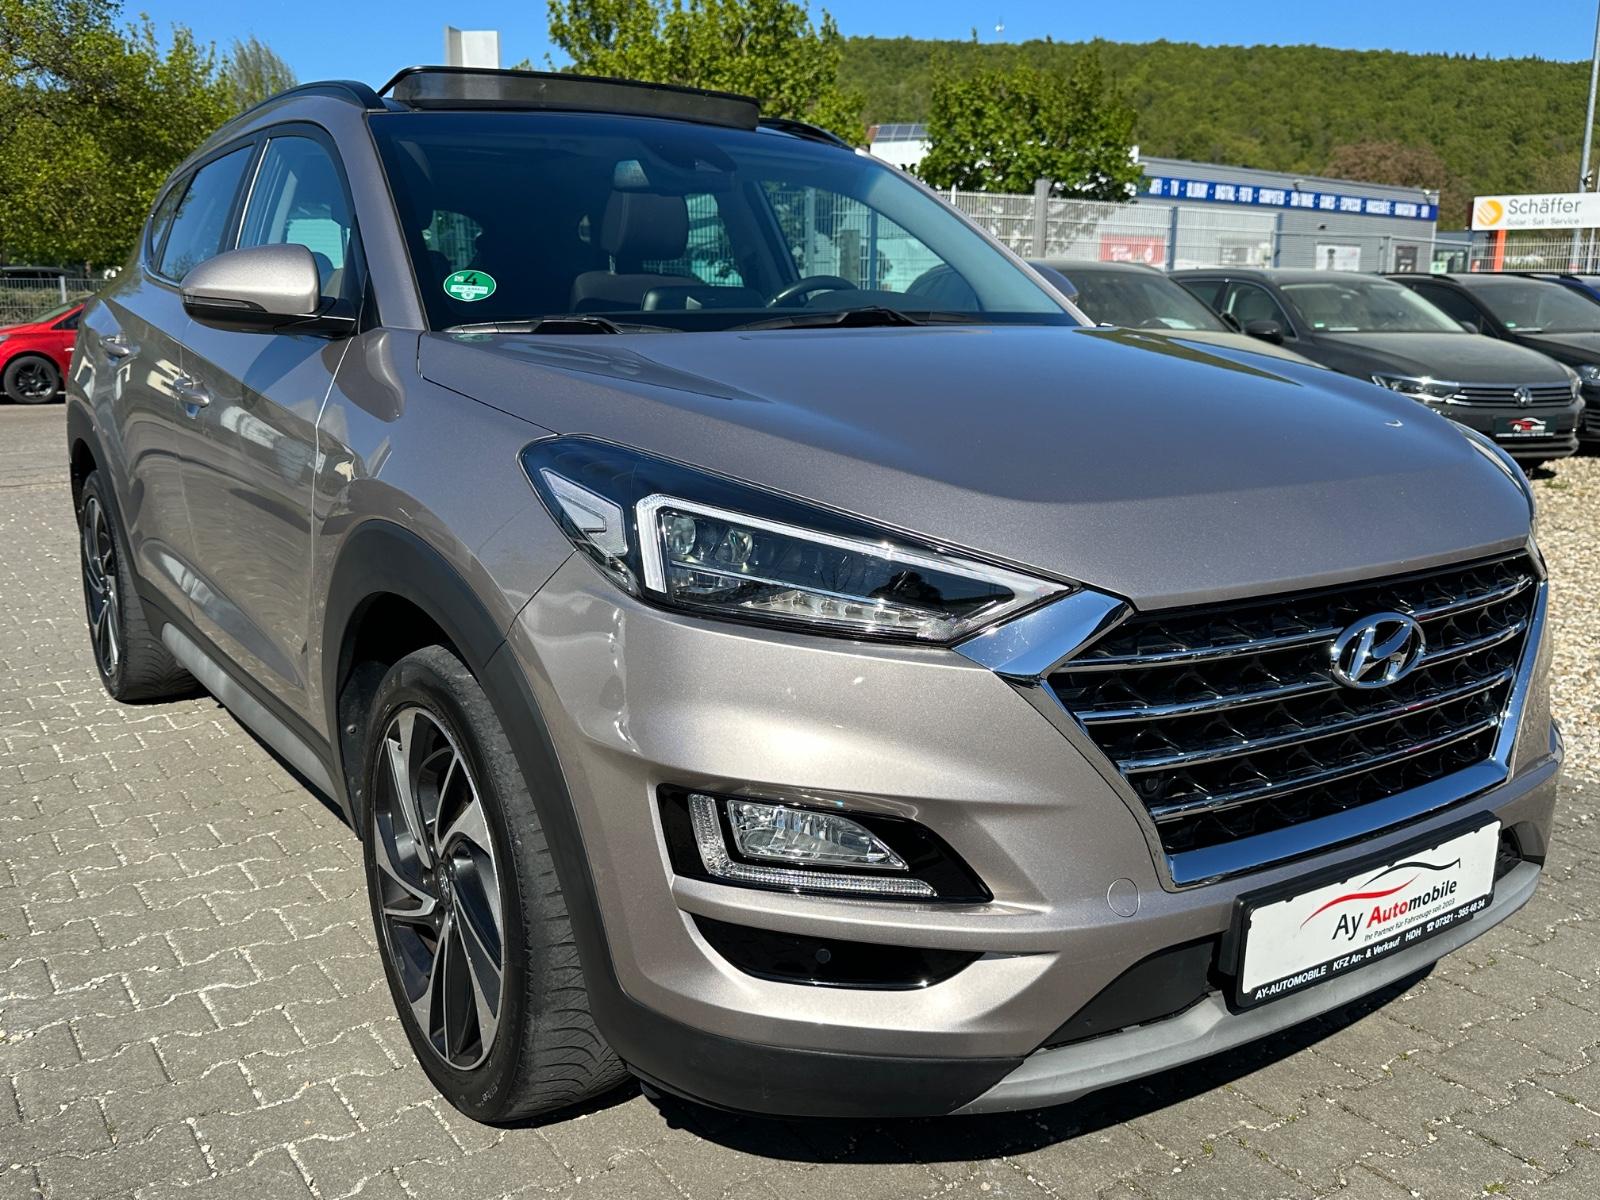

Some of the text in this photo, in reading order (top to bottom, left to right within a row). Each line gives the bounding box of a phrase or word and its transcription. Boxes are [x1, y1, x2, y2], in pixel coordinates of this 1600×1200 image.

[1508, 197, 1582, 215] Schäffer
[1332, 879, 1457, 941] Ay Automobile
[1374, 924, 1396, 939] Partner
[1254, 965, 1328, 1000] AY-AUTOMOBILE
[1332, 956, 1351, 972] KFZ
[1350, 953, 1365, 965] An-
[1365, 948, 1372, 959] &
[1373, 936, 1401, 956] Verkauf
[1405, 926, 1422, 942] HDH
